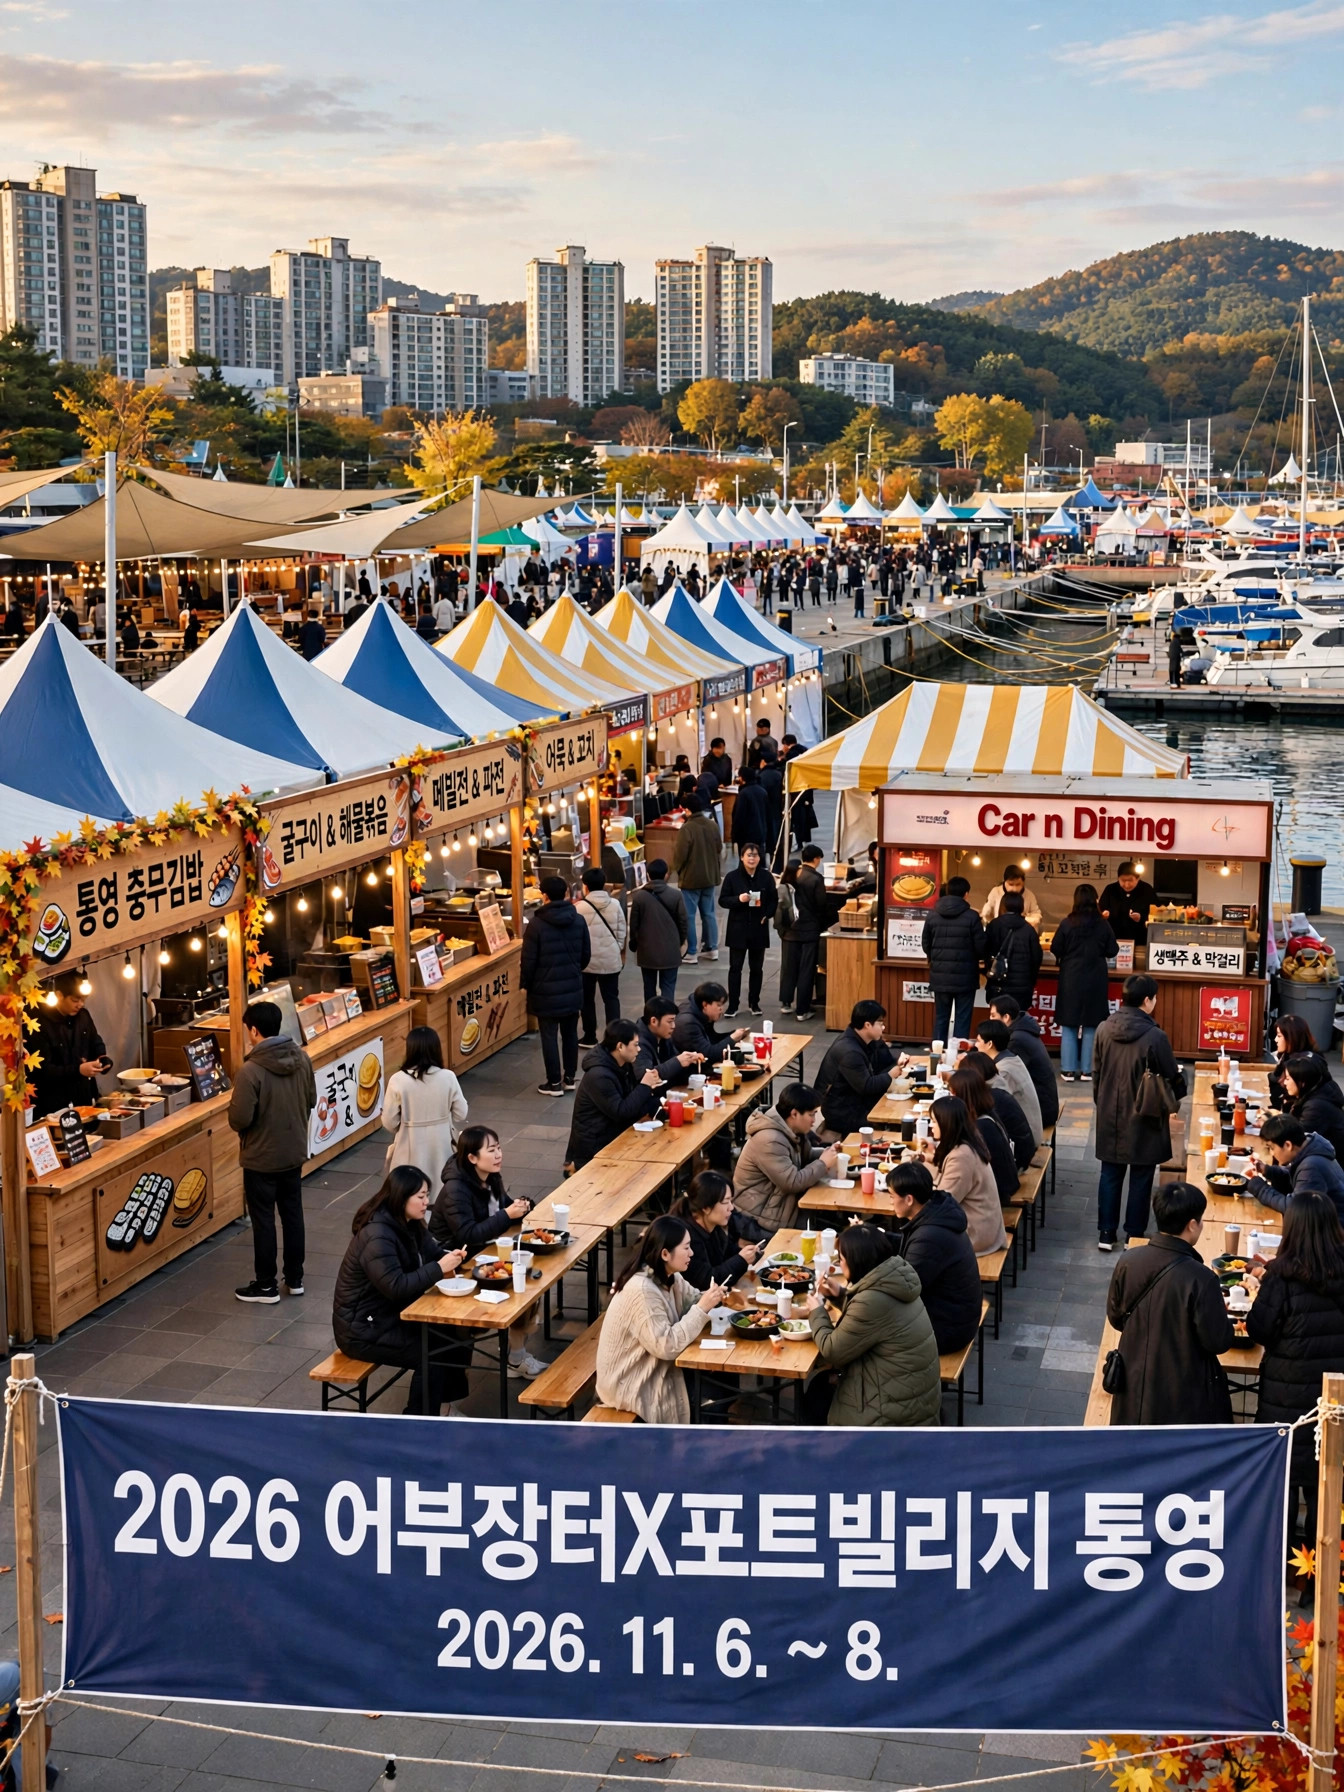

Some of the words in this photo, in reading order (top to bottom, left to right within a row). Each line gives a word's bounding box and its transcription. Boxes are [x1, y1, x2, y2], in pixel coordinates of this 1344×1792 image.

[472, 769, 480, 799] &
[483, 758, 505, 797] 파전
[568, 739, 575, 766] &
[280, 812, 322, 865] 굴구이
[326, 814, 336, 847] &
[339, 794, 388, 844] 해물볶음
[978, 804, 1036, 837] Car
[1044, 814, 1063, 838] n
[1074, 806, 1176, 850] Dining
[76, 871, 119, 937] 통영
[126, 850, 204, 921] 충무김밥
[1153, 949, 1189, 967] 생맥주
[1192, 952, 1202, 966] &
[1205, 952, 1241, 970] 막걸리
[114, 1470, 300, 1562] 2026
[325, 1477, 1050, 1589] 어부장터X포트빌리지
[1075, 1490, 1225, 1592] 통영
[437, 1608, 601, 1673] 2026.
[622, 1616, 695, 1676] 11.
[715, 1617, 767, 1678] 6.
[787, 1639, 828, 1660] ~
[845, 1620, 898, 1681] 8.
